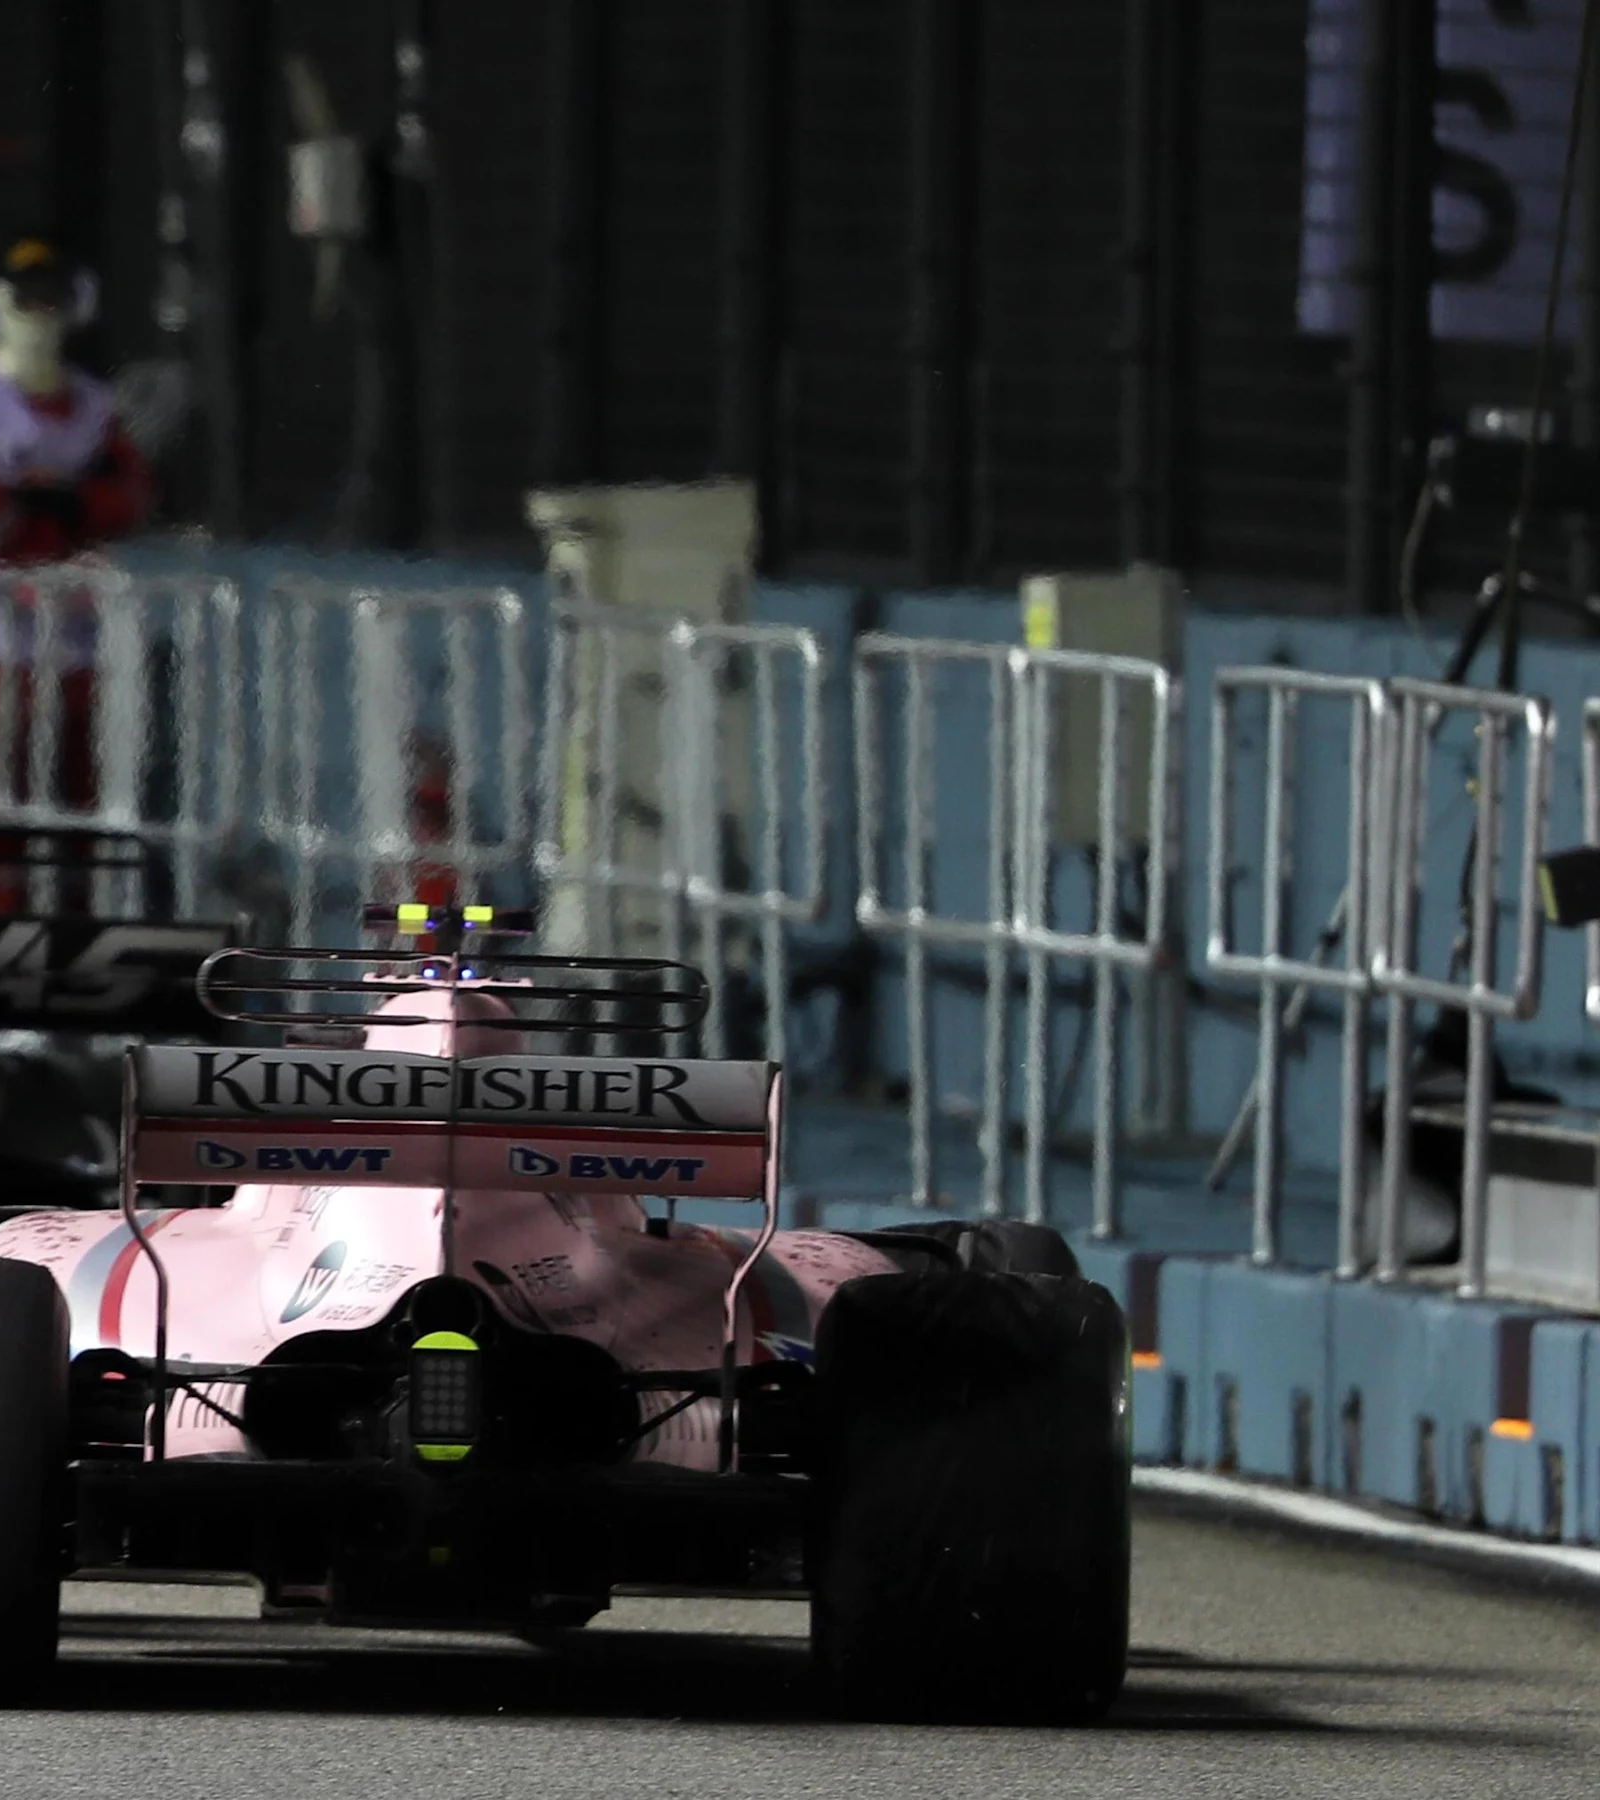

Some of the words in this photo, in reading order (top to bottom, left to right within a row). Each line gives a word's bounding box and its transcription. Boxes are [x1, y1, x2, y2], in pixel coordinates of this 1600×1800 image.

[192, 1053, 712, 1125] KINGFISHER
[255, 1147, 392, 1173] BWT
[569, 1155, 706, 1183] BWT
